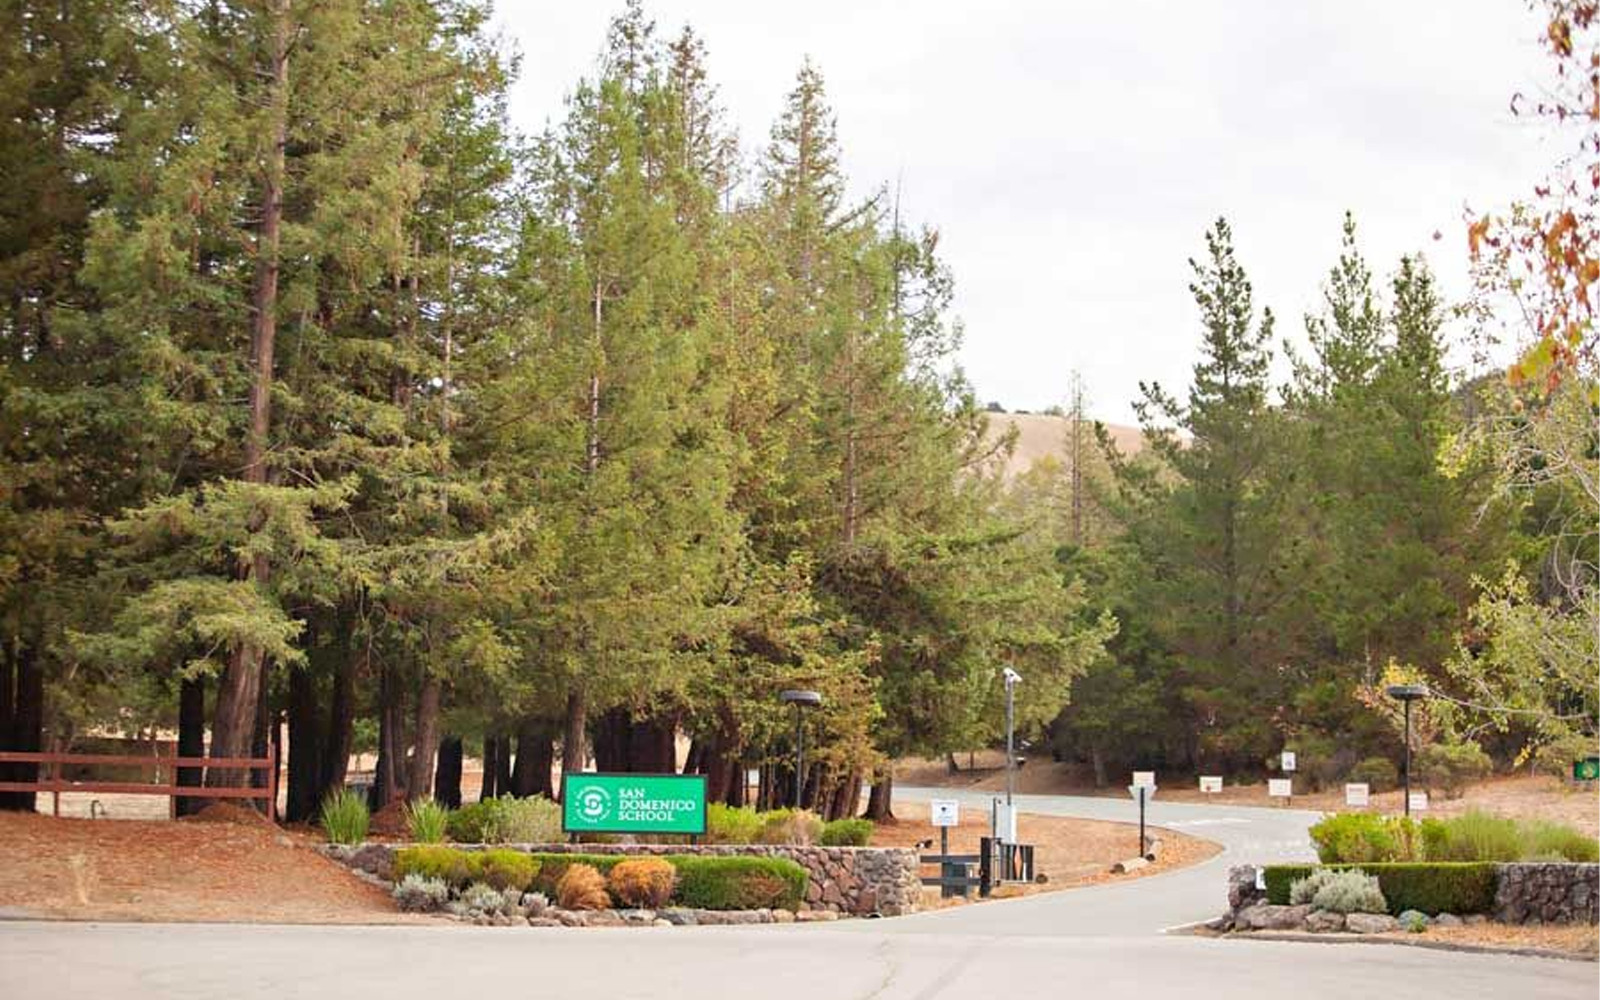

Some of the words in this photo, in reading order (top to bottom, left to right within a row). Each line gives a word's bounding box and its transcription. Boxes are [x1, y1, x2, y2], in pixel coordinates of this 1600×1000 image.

[618, 788, 645, 799] SAN
[619, 799, 696, 811] DOMENICO
[618, 810, 675, 821] SCHOOL
